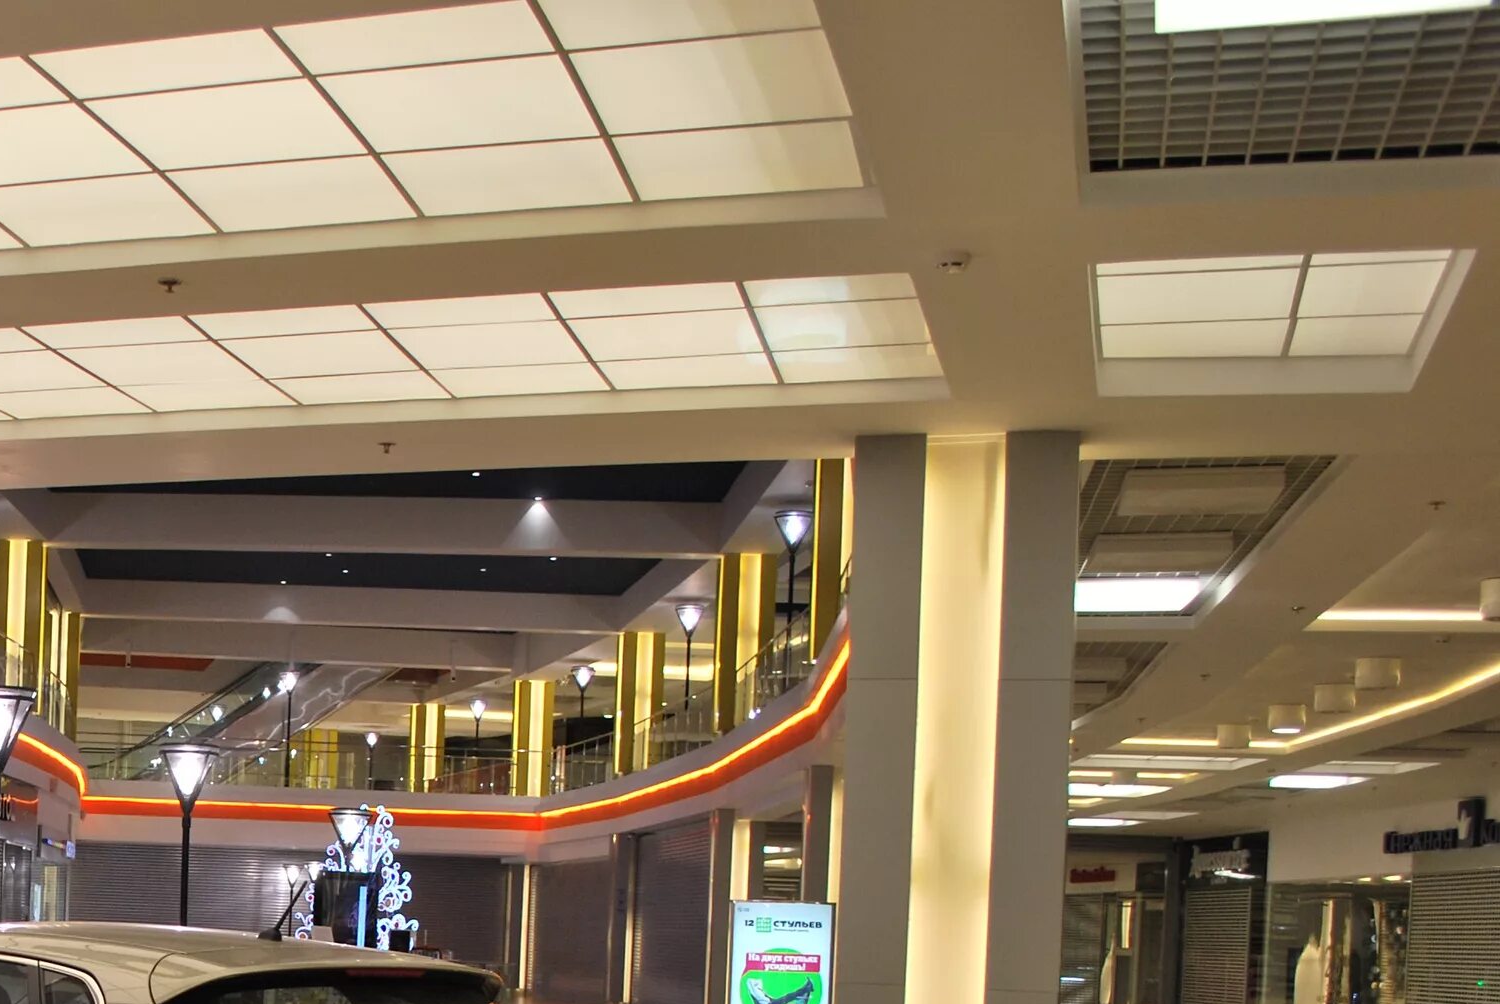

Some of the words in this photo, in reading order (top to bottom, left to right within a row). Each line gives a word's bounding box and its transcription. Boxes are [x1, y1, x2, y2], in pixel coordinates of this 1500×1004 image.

[744, 919, 755, 927] 12
[773, 920, 823, 929] СТУЛЬЕВ
[748, 953, 760, 962] На
[761, 954, 783, 963] двух
[784, 955, 819, 965] стульях
